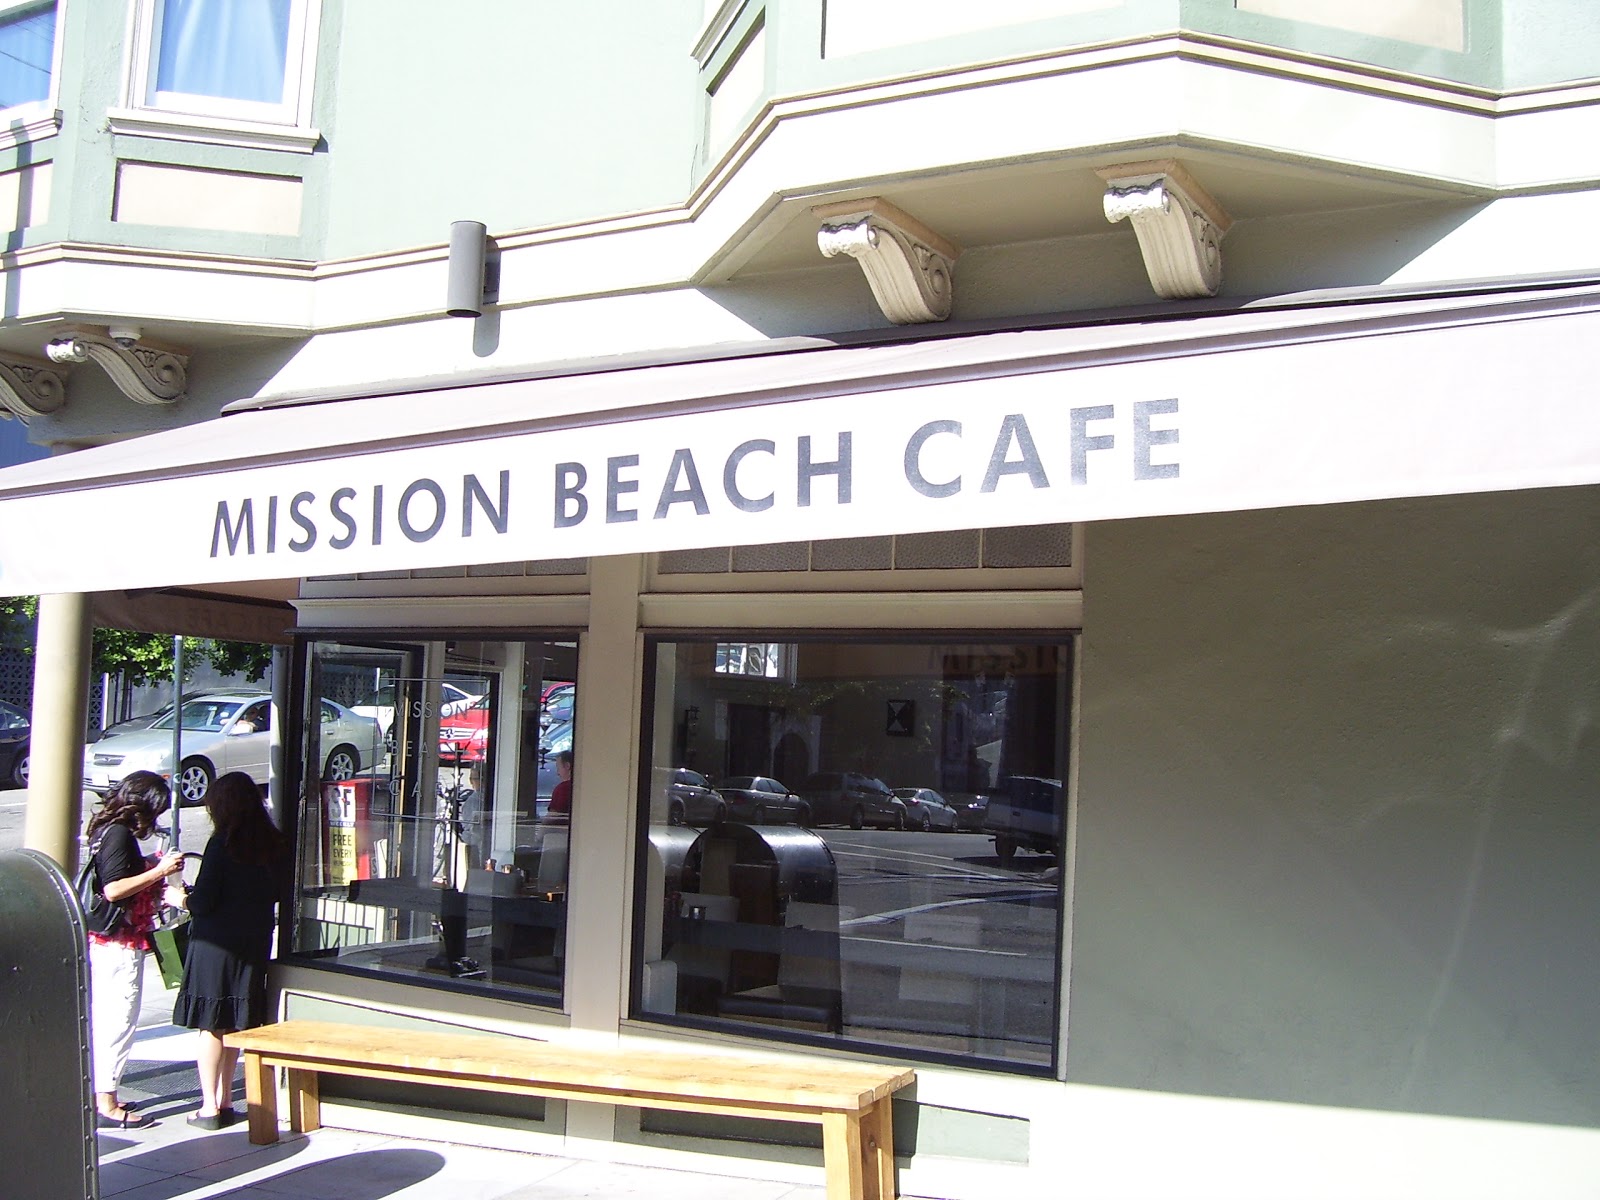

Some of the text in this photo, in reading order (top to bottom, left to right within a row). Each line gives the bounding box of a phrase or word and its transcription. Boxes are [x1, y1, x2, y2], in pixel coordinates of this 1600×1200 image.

[210, 398, 1180, 558] MISSION BEACH CAFE
[393, 701, 468, 721] MISSION
[391, 739, 466, 760] BEACH
[389, 779, 464, 802] CAFE
[332, 834, 352, 847] FREE
[332, 848, 353, 859] EVERY
